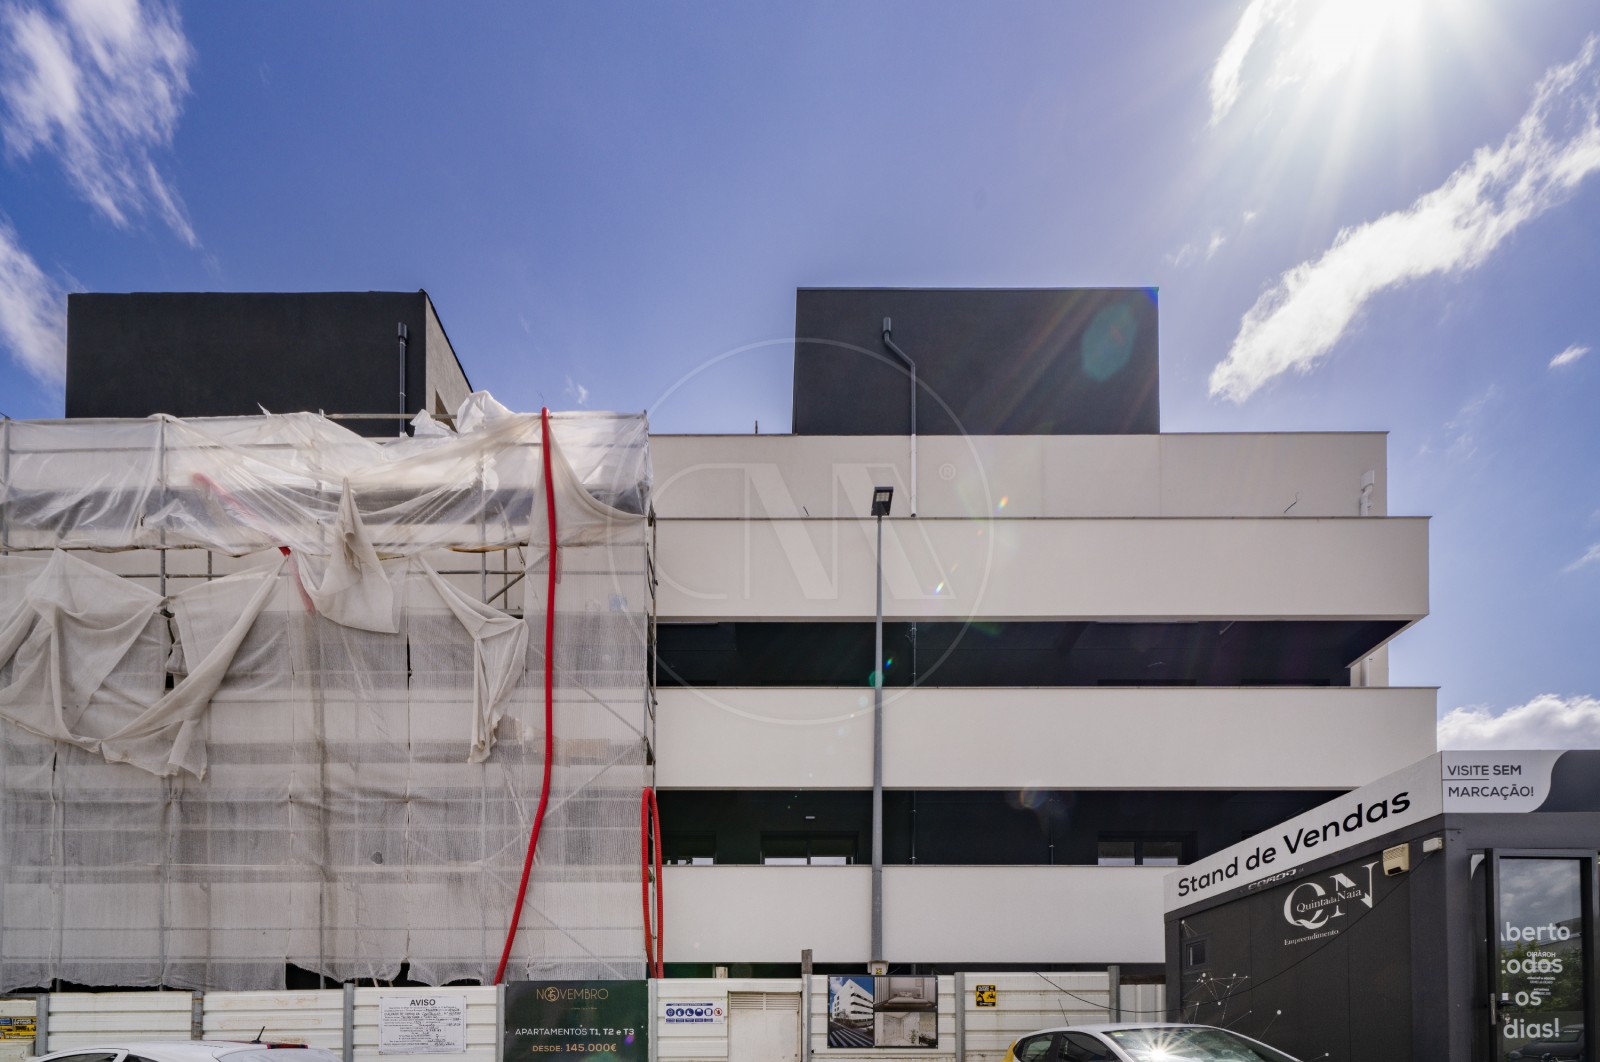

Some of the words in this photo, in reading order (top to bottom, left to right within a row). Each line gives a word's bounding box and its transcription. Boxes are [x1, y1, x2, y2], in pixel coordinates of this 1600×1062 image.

[1447, 765, 1489, 776] VISITE
[1493, 765, 1522, 776] SEM
[1448, 783, 1534, 800] MARCAÇÃO!
[1178, 856, 1238, 897] Stand
[1245, 847, 1277, 871] de
[1283, 791, 1411, 855] Vendas
[1284, 929, 1339, 946] Empreendimento
[1515, 990, 1542, 1006] os
[515, 1028, 588, 1036] APARTAMENTOS
[603, 1028, 614, 1036] T2
[623, 1028, 635, 1036] T3
[1503, 1017, 1560, 1039] dias!
[565, 1044, 617, 1052] 145.000€
